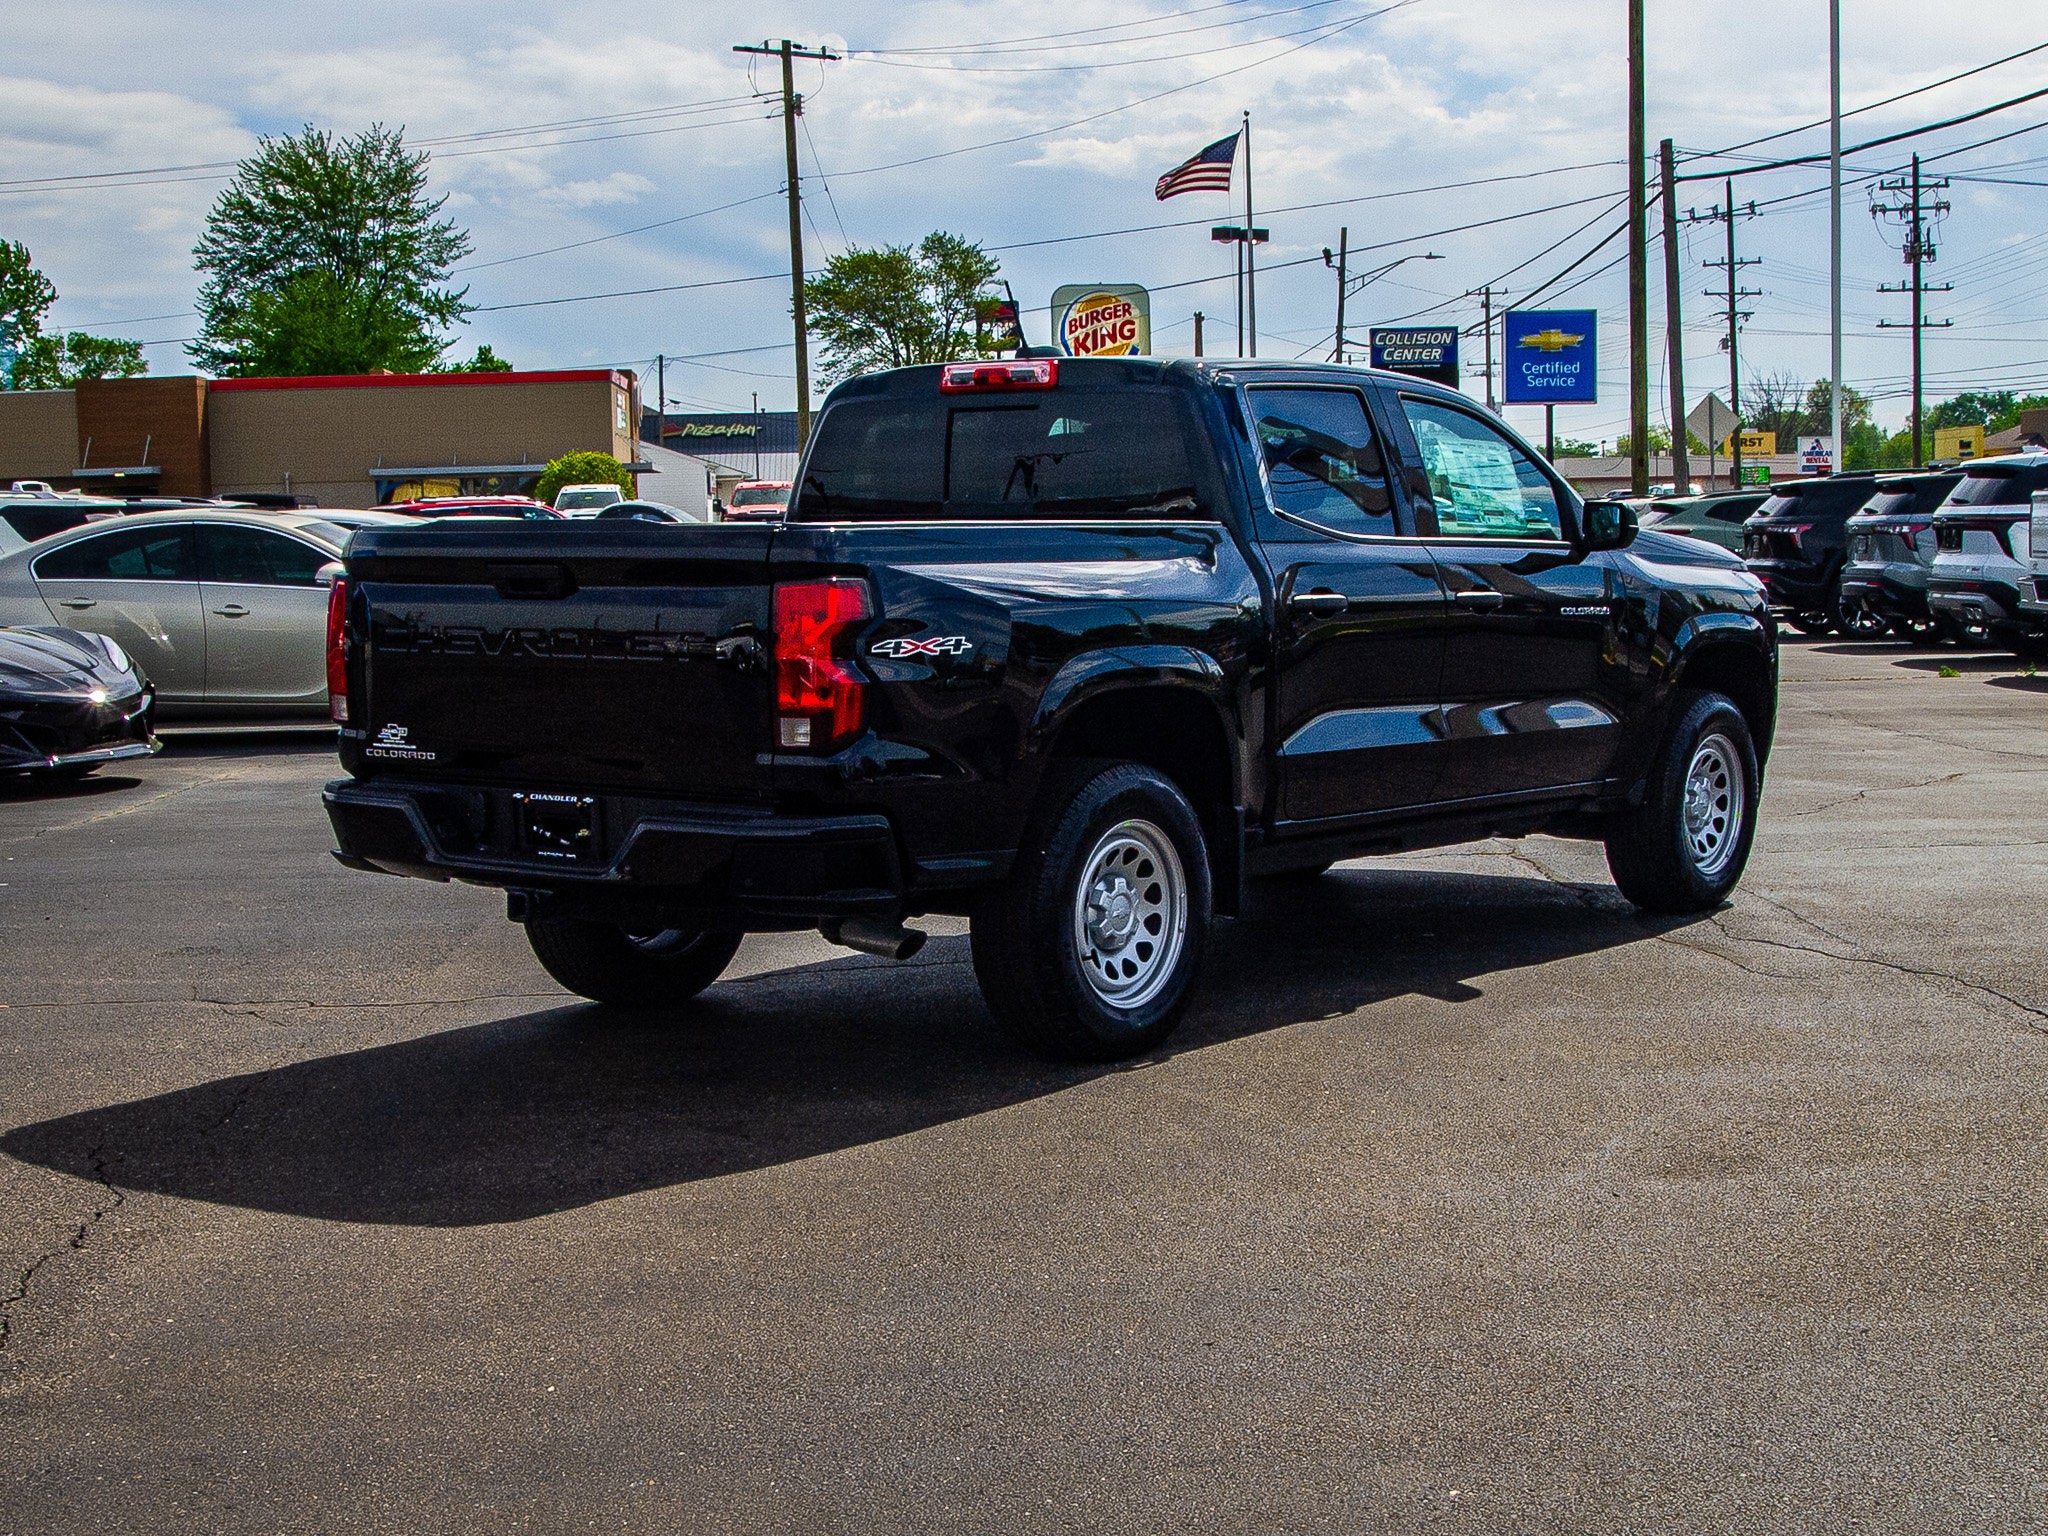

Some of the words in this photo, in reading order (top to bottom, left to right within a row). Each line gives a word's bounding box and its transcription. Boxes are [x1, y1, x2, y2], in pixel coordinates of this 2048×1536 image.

[1068, 302, 1132, 335] BURGER
[1073, 319, 1136, 356] KING
[1375, 332, 1452, 345] COLLISION
[1383, 347, 1442, 361] CENTER
[1522, 361, 1580, 374] Certified
[1527, 374, 1576, 387] Service
[1730, 437, 1764, 447] RST
[365, 748, 436, 760] COLORADO
[530, 793, 578, 803] CHANDLER
